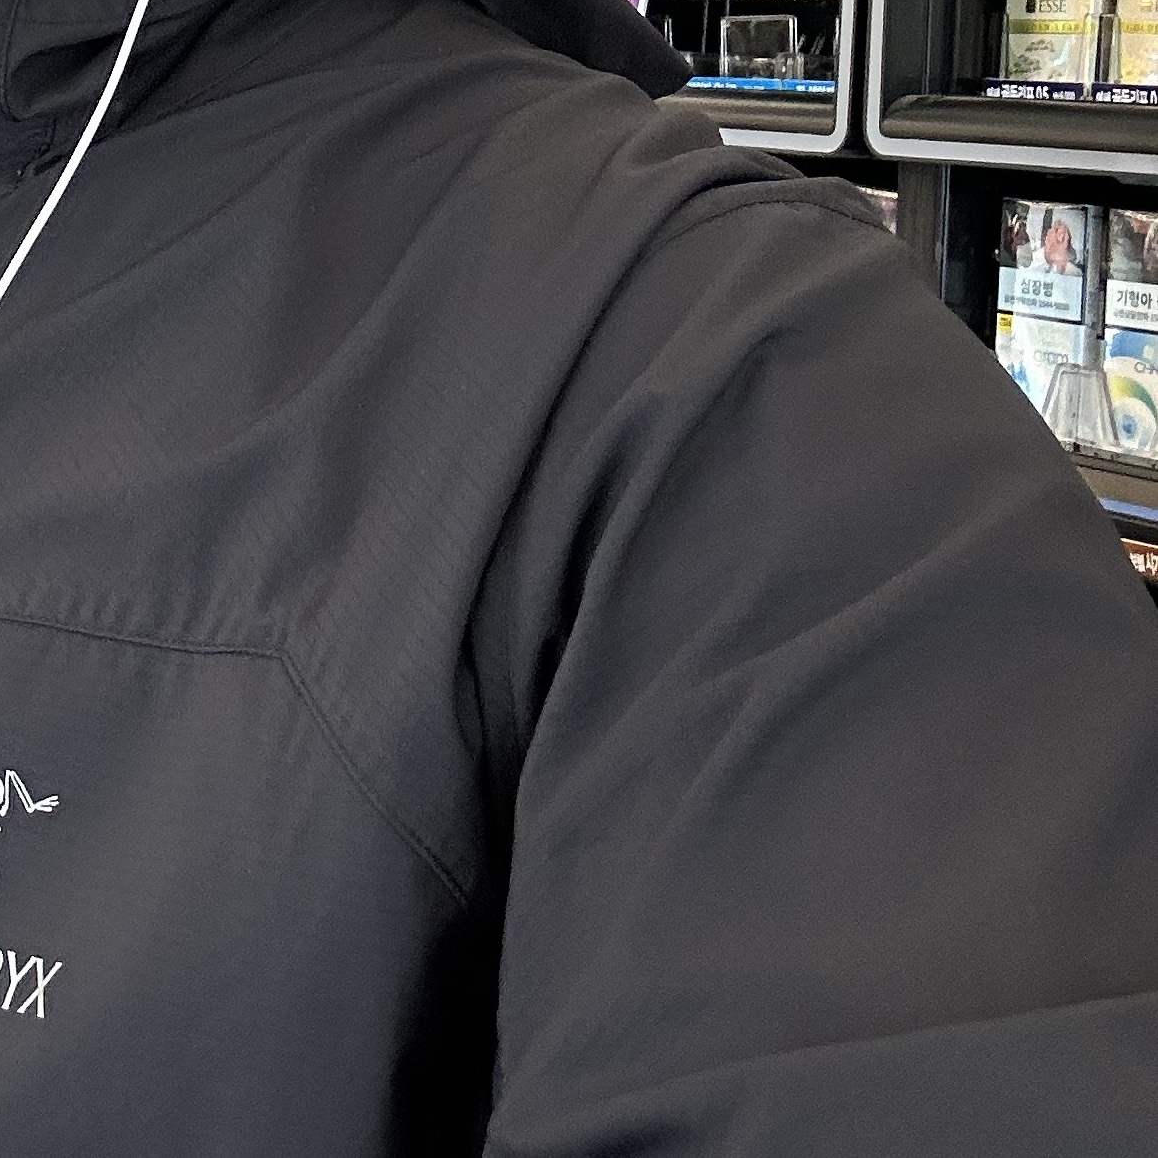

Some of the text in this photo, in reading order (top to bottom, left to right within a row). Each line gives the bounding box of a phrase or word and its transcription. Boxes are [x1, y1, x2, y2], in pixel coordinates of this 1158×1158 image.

[1039, 0, 1066, 14] ESSE
[1021, 278, 1054, 298] 심장병
[1117, 289, 1152, 310] 기형아
